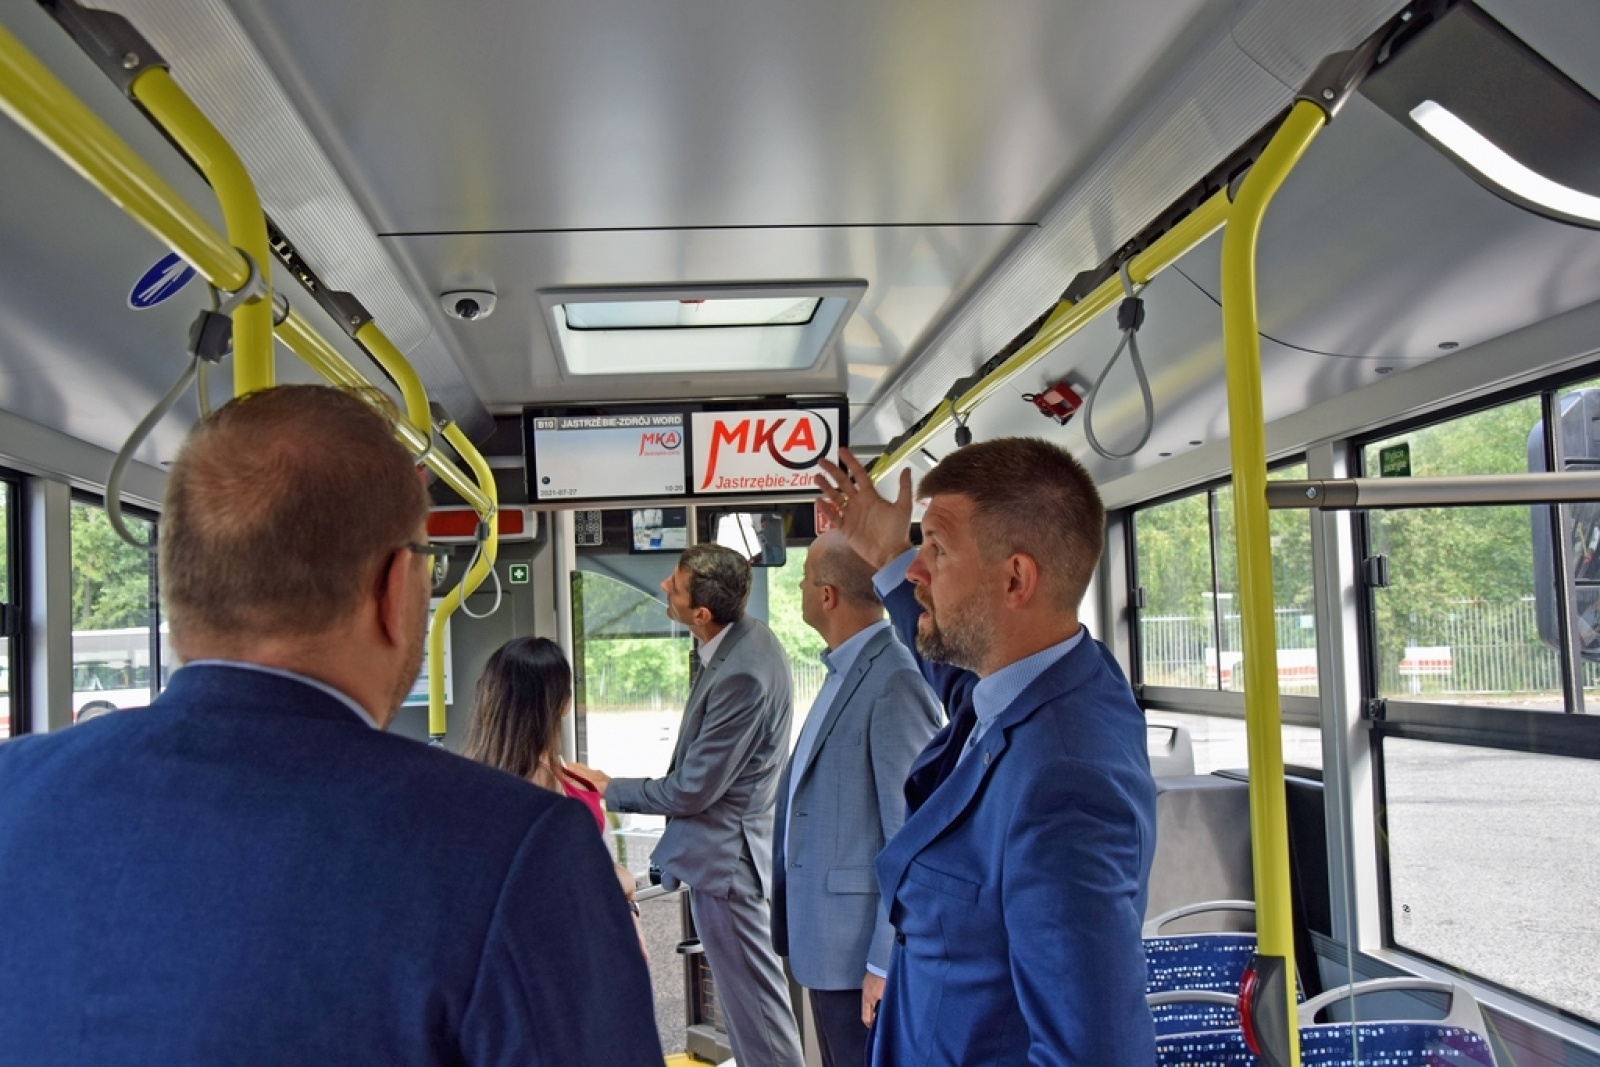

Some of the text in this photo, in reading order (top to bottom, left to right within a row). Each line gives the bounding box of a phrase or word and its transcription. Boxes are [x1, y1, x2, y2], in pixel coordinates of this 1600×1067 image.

[537, 421, 553, 429] B10
[652, 416, 682, 425] WORD
[639, 431, 679, 456] MKA
[701, 416, 820, 489] MKA
[715, 474, 817, 491] Jastrzębie-Zdr
[540, 488, 578, 497] 2021-07-27
